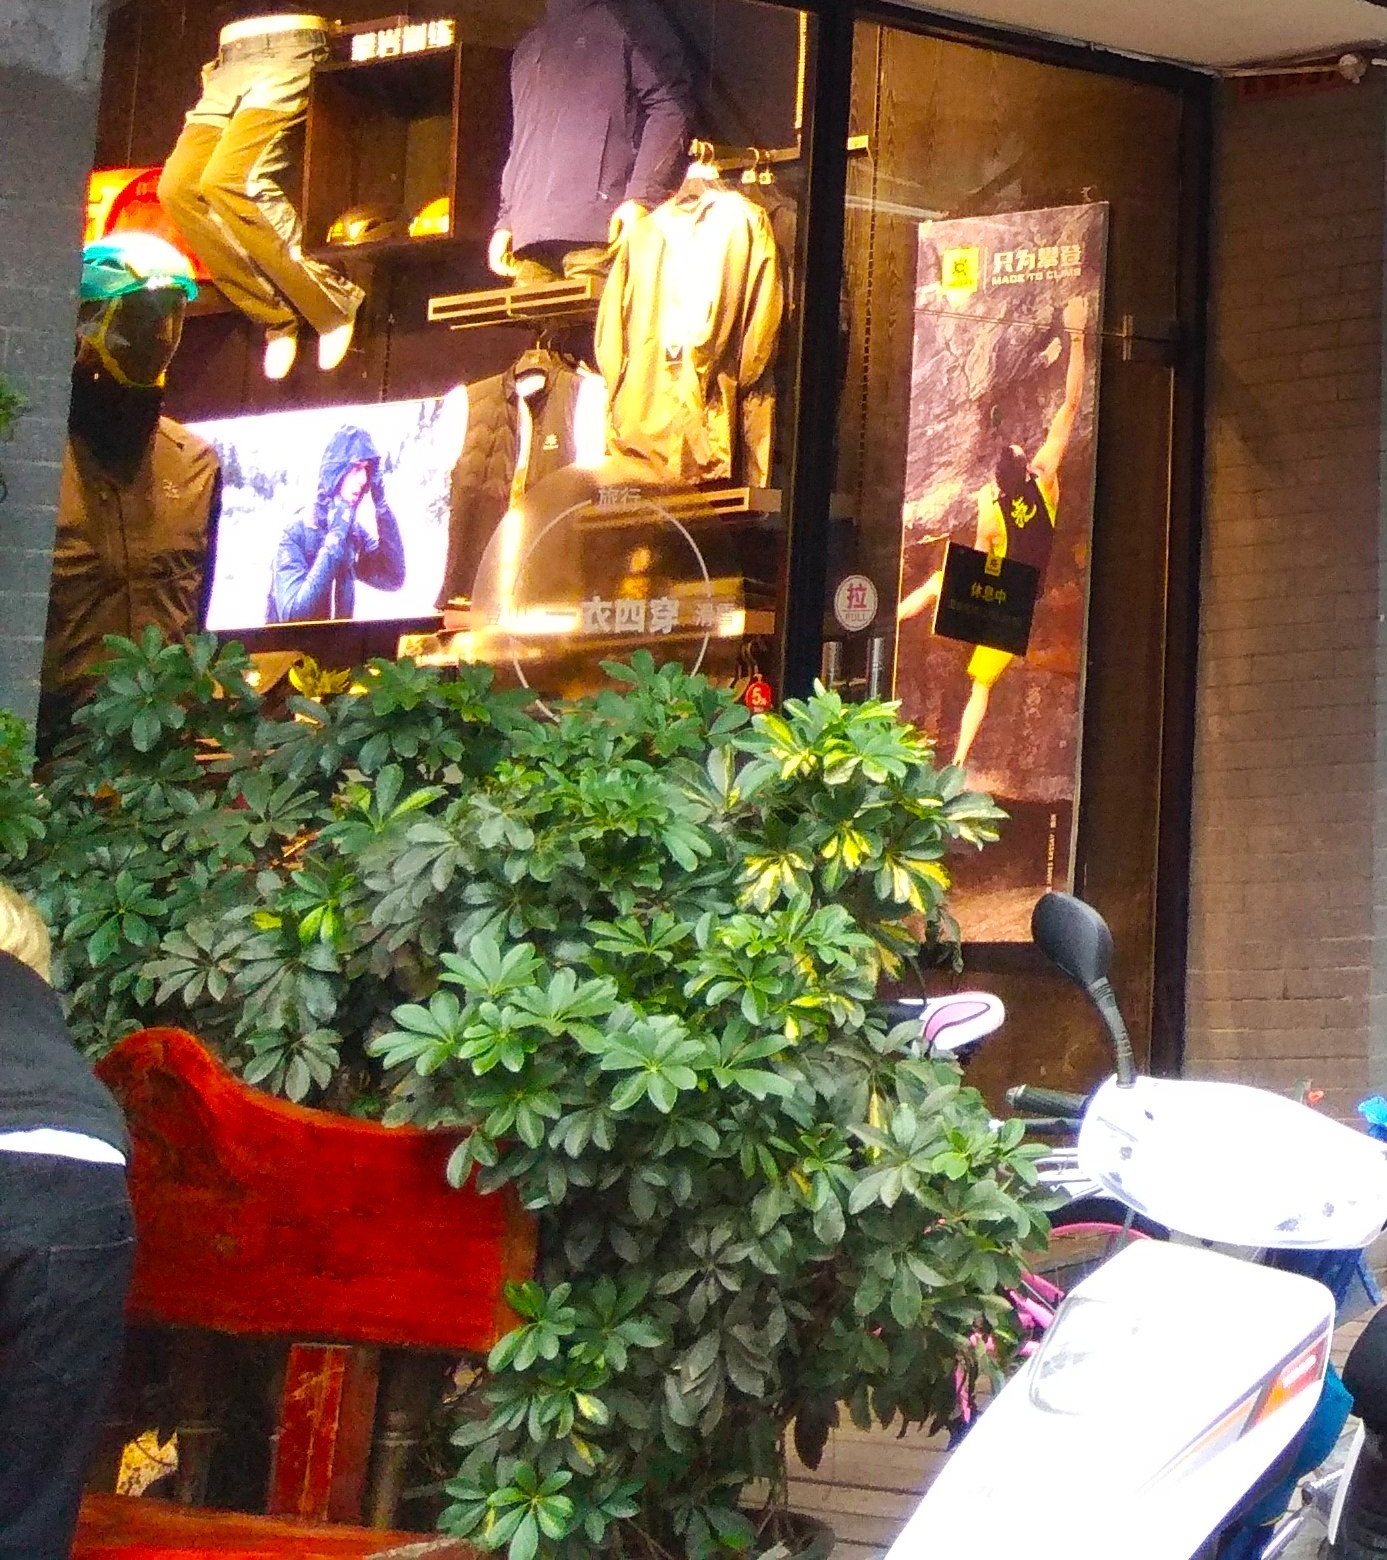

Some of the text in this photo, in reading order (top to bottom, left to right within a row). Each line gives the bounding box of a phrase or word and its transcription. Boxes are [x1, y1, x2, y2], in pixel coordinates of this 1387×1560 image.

[992, 274, 1025, 286] MADE
[1028, 272, 1043, 282] TO
[847, 583, 867, 609] 拉
